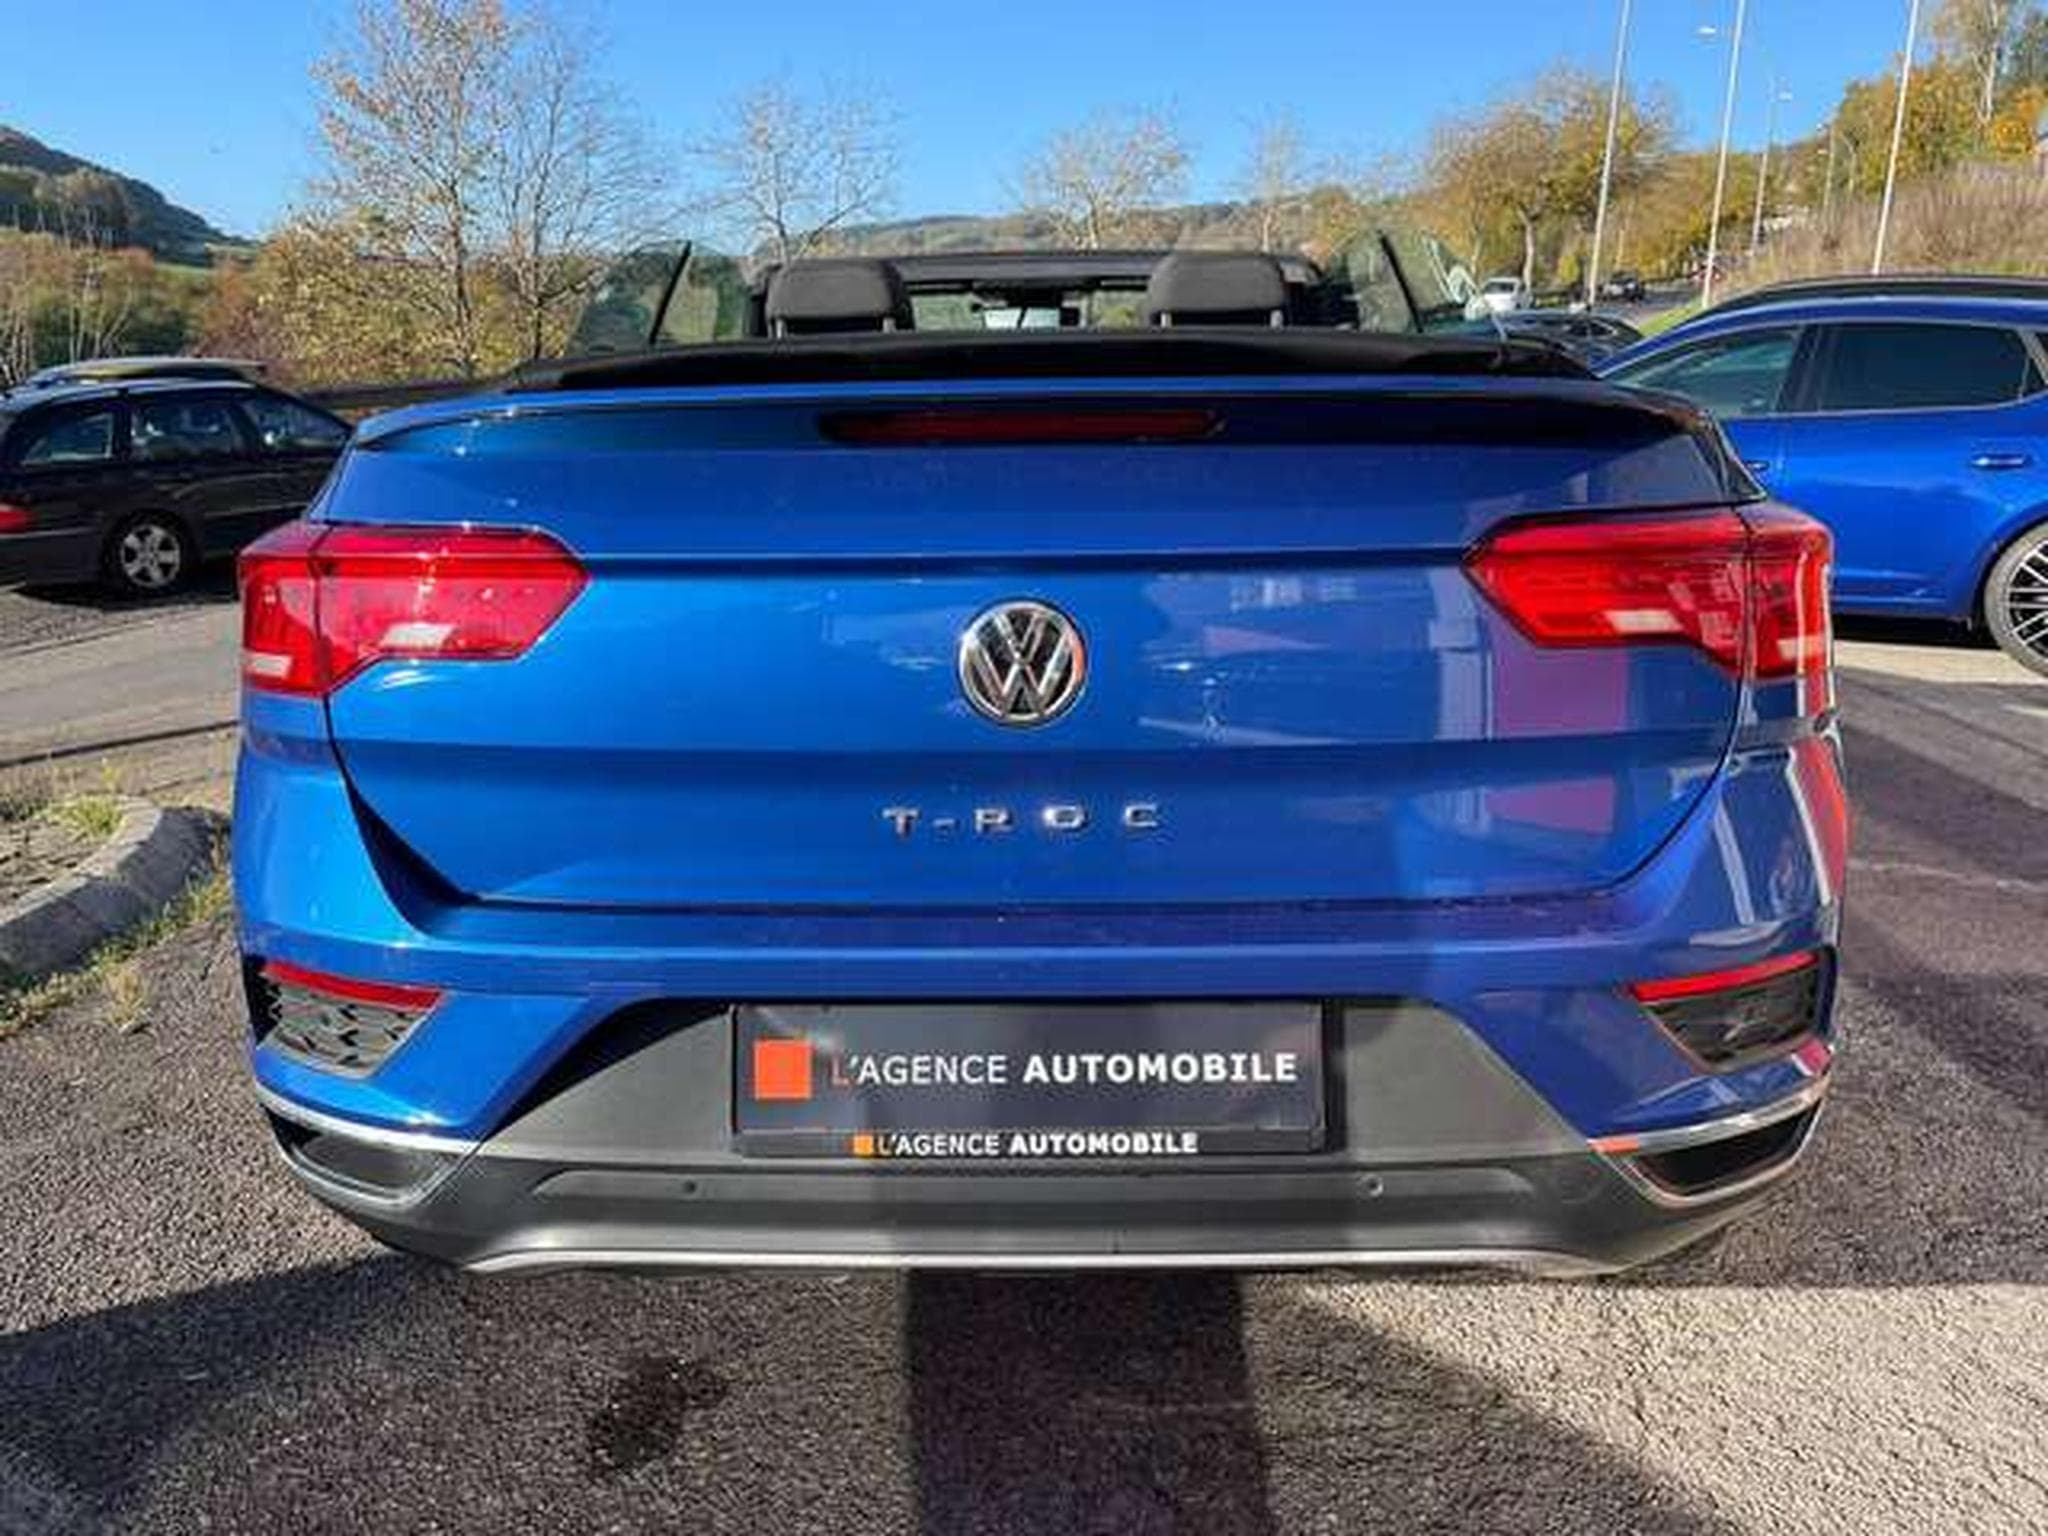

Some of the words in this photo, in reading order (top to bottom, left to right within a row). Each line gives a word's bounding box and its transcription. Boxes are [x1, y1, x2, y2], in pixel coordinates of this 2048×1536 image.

[882, 803, 1160, 836] T-ROC
[832, 1053, 1006, 1086] L'AGENCE
[1023, 1052, 1297, 1084] AUTOMOBILE
[878, 1133, 1001, 1157] L'AGENCE
[1008, 1132, 1199, 1156] AUTOMOBILE
